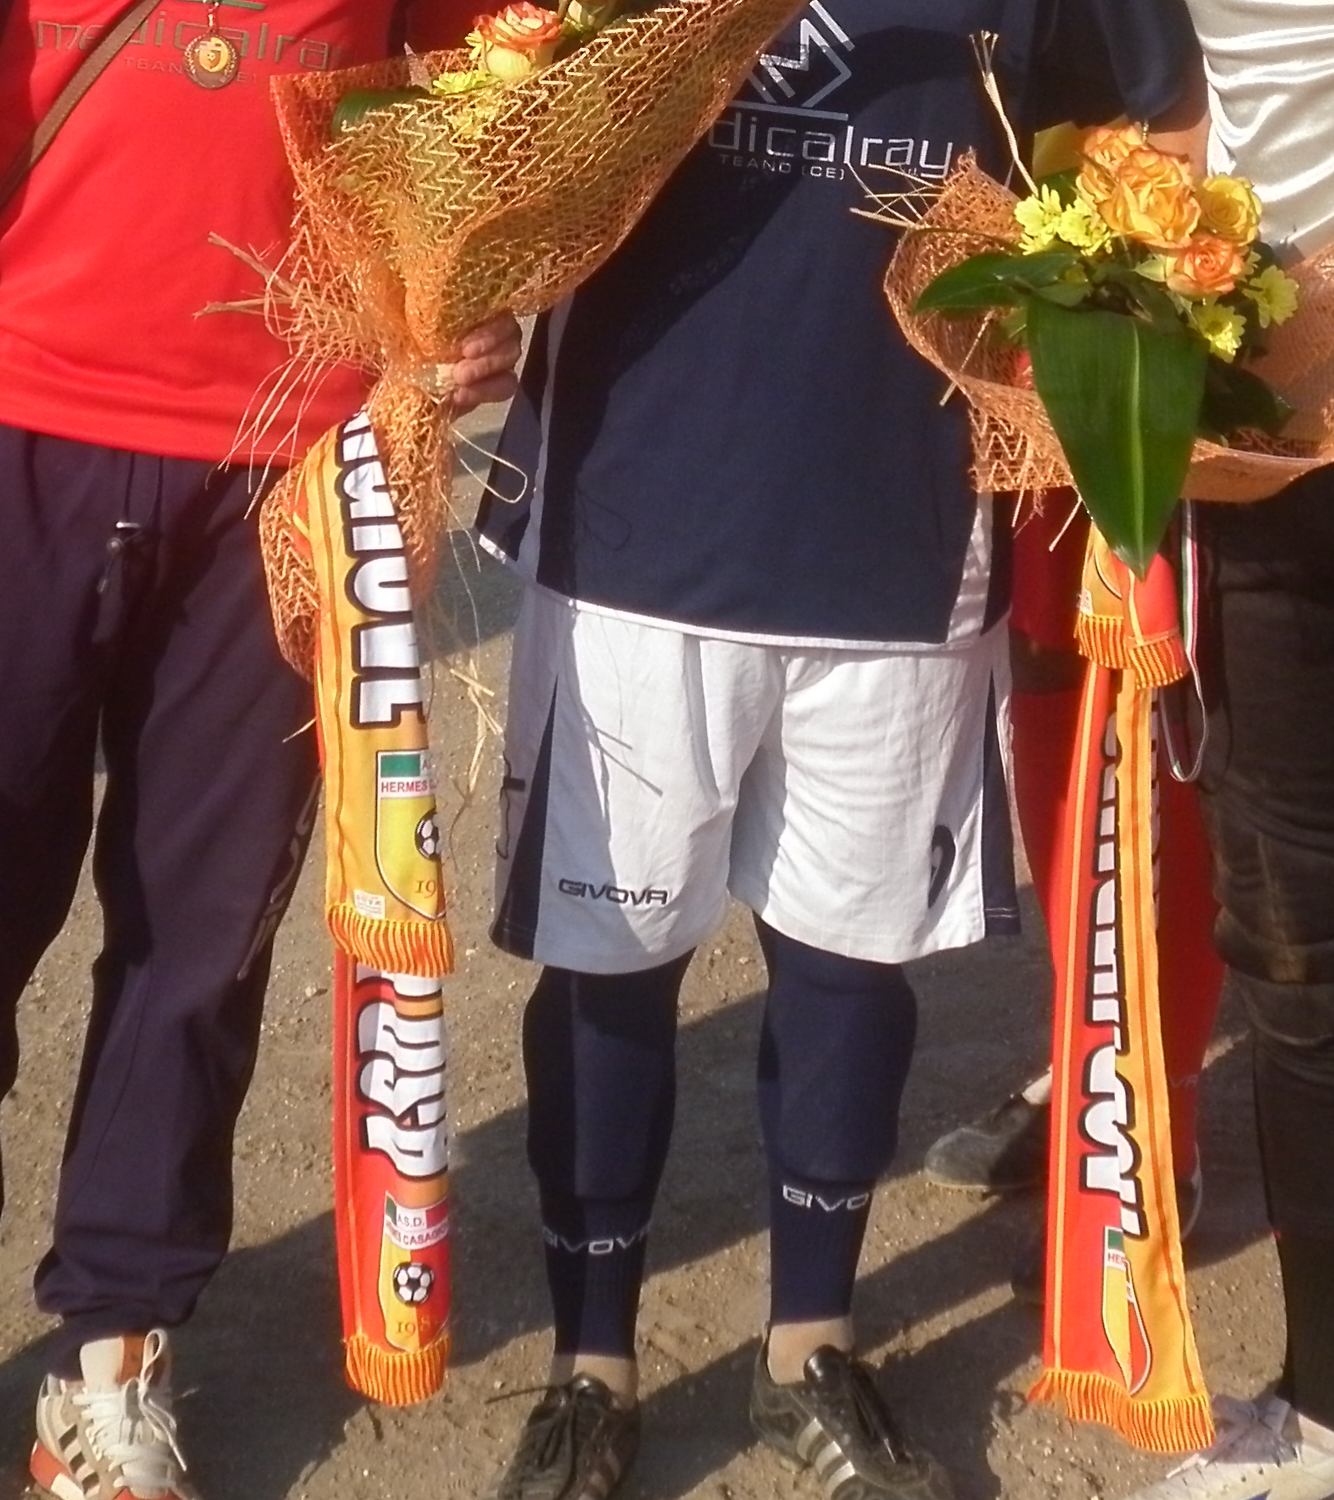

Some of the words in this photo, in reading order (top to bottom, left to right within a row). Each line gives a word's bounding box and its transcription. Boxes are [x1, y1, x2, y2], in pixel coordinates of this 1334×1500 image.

[124, 56, 187, 75] TEAN
[720, 154, 792, 174] TEANO
[558, 878, 668, 906] GIVOVA
